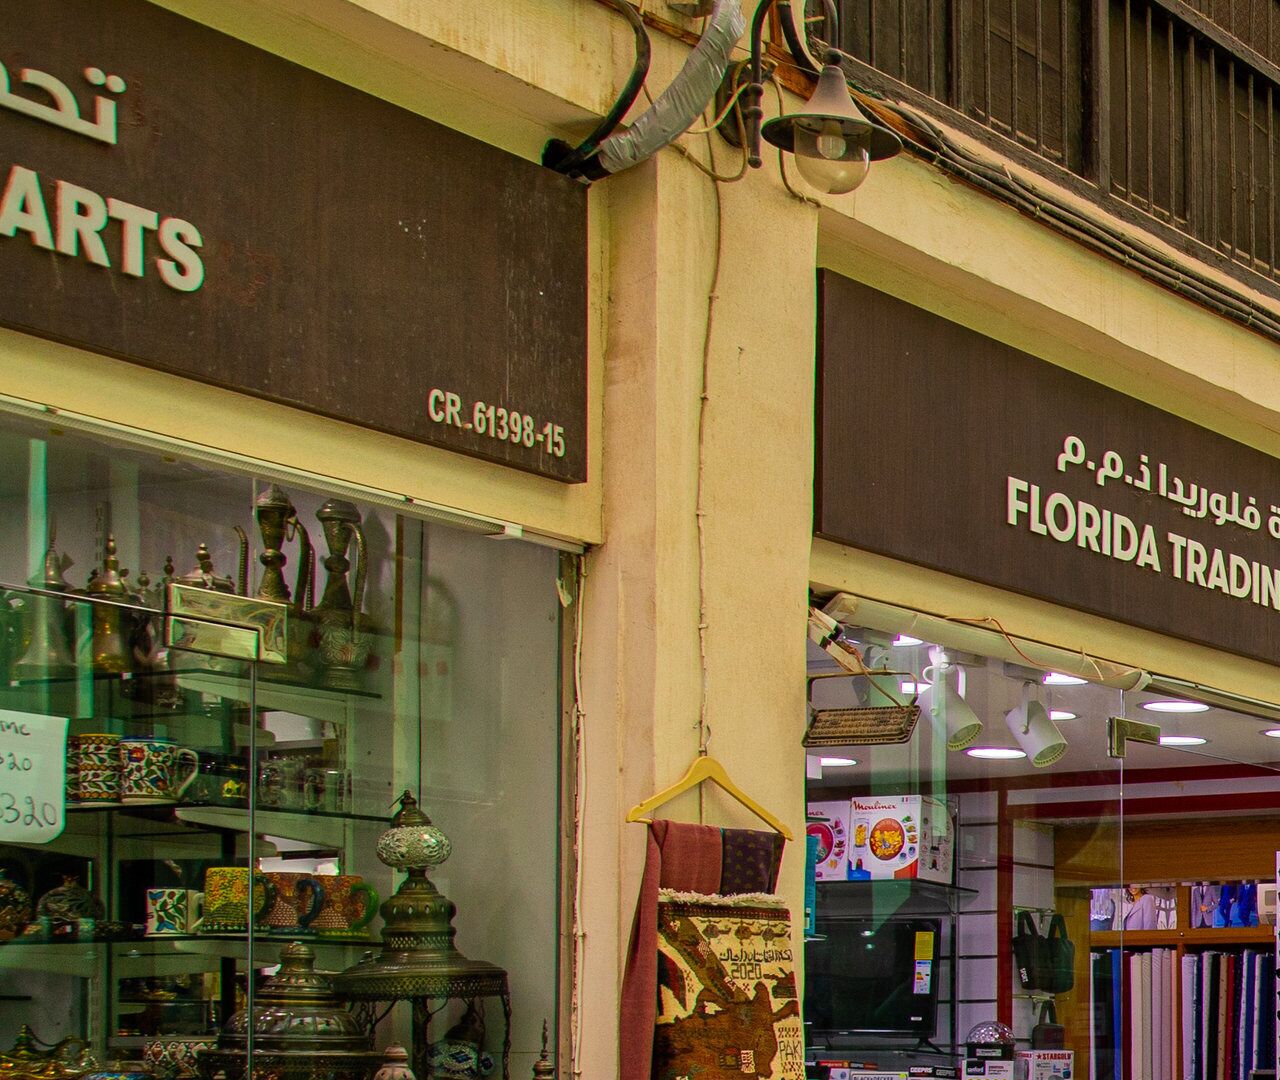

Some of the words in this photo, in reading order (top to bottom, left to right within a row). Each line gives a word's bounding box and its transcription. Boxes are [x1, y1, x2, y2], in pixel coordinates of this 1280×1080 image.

[0, 165, 204, 292] ARTS
[1006, 476, 1161, 573] FLORIDA
[1158, 462, 1261, 531] فلوريدا
[731, 962, 762, 980] 2020
